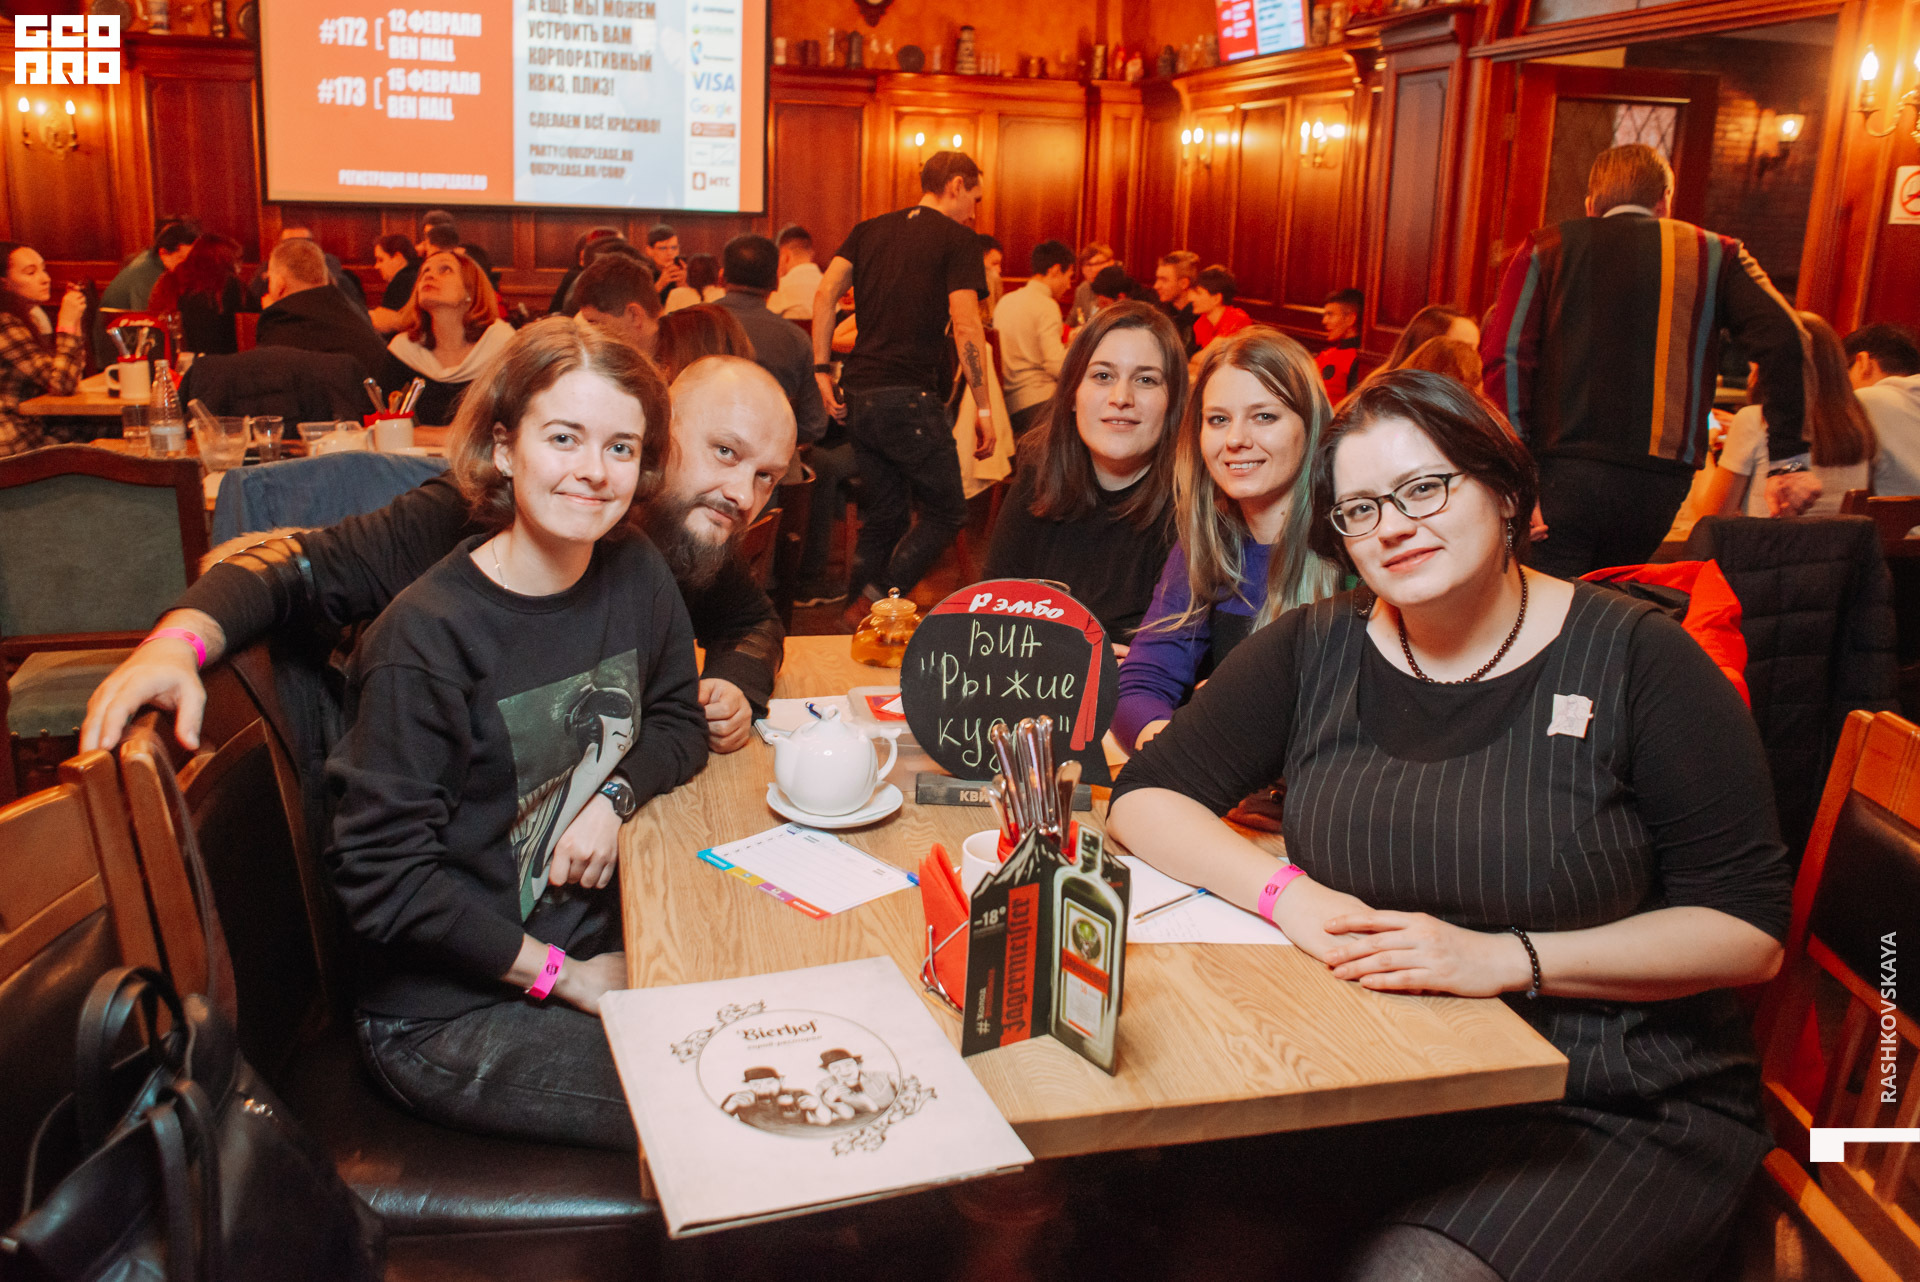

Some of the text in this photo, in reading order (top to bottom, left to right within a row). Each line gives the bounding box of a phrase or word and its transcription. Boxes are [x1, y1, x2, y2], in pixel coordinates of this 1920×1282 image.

[387, 8, 482, 37] 12 ФЕВРАЛЯ
[573, 0, 599, 16] МЫ
[603, 1, 656, 20] МОЖЕМ
[319, 16, 368, 47] #172
[528, 20, 632, 44] УСТРОИТЬ ВАМ
[388, 35, 456, 62] BEN HALL
[528, 46, 653, 72] КОРПОРАТИВНЫЙ
[317, 76, 367, 107] #173
[387, 67, 481, 95] 15 ФЕВРАЛЯ
[528, 72, 615, 96] КВИЗ, ПЛИЗ!
[690, 72, 735, 92] VISA
[387, 95, 454, 121] BEN HALL
[689, 97, 732, 119] Google
[529, 112, 581, 129] СДЕЛАЕМ
[607, 116, 661, 134] КРАСИВО!
[969, 619, 1042, 658] ВИА
